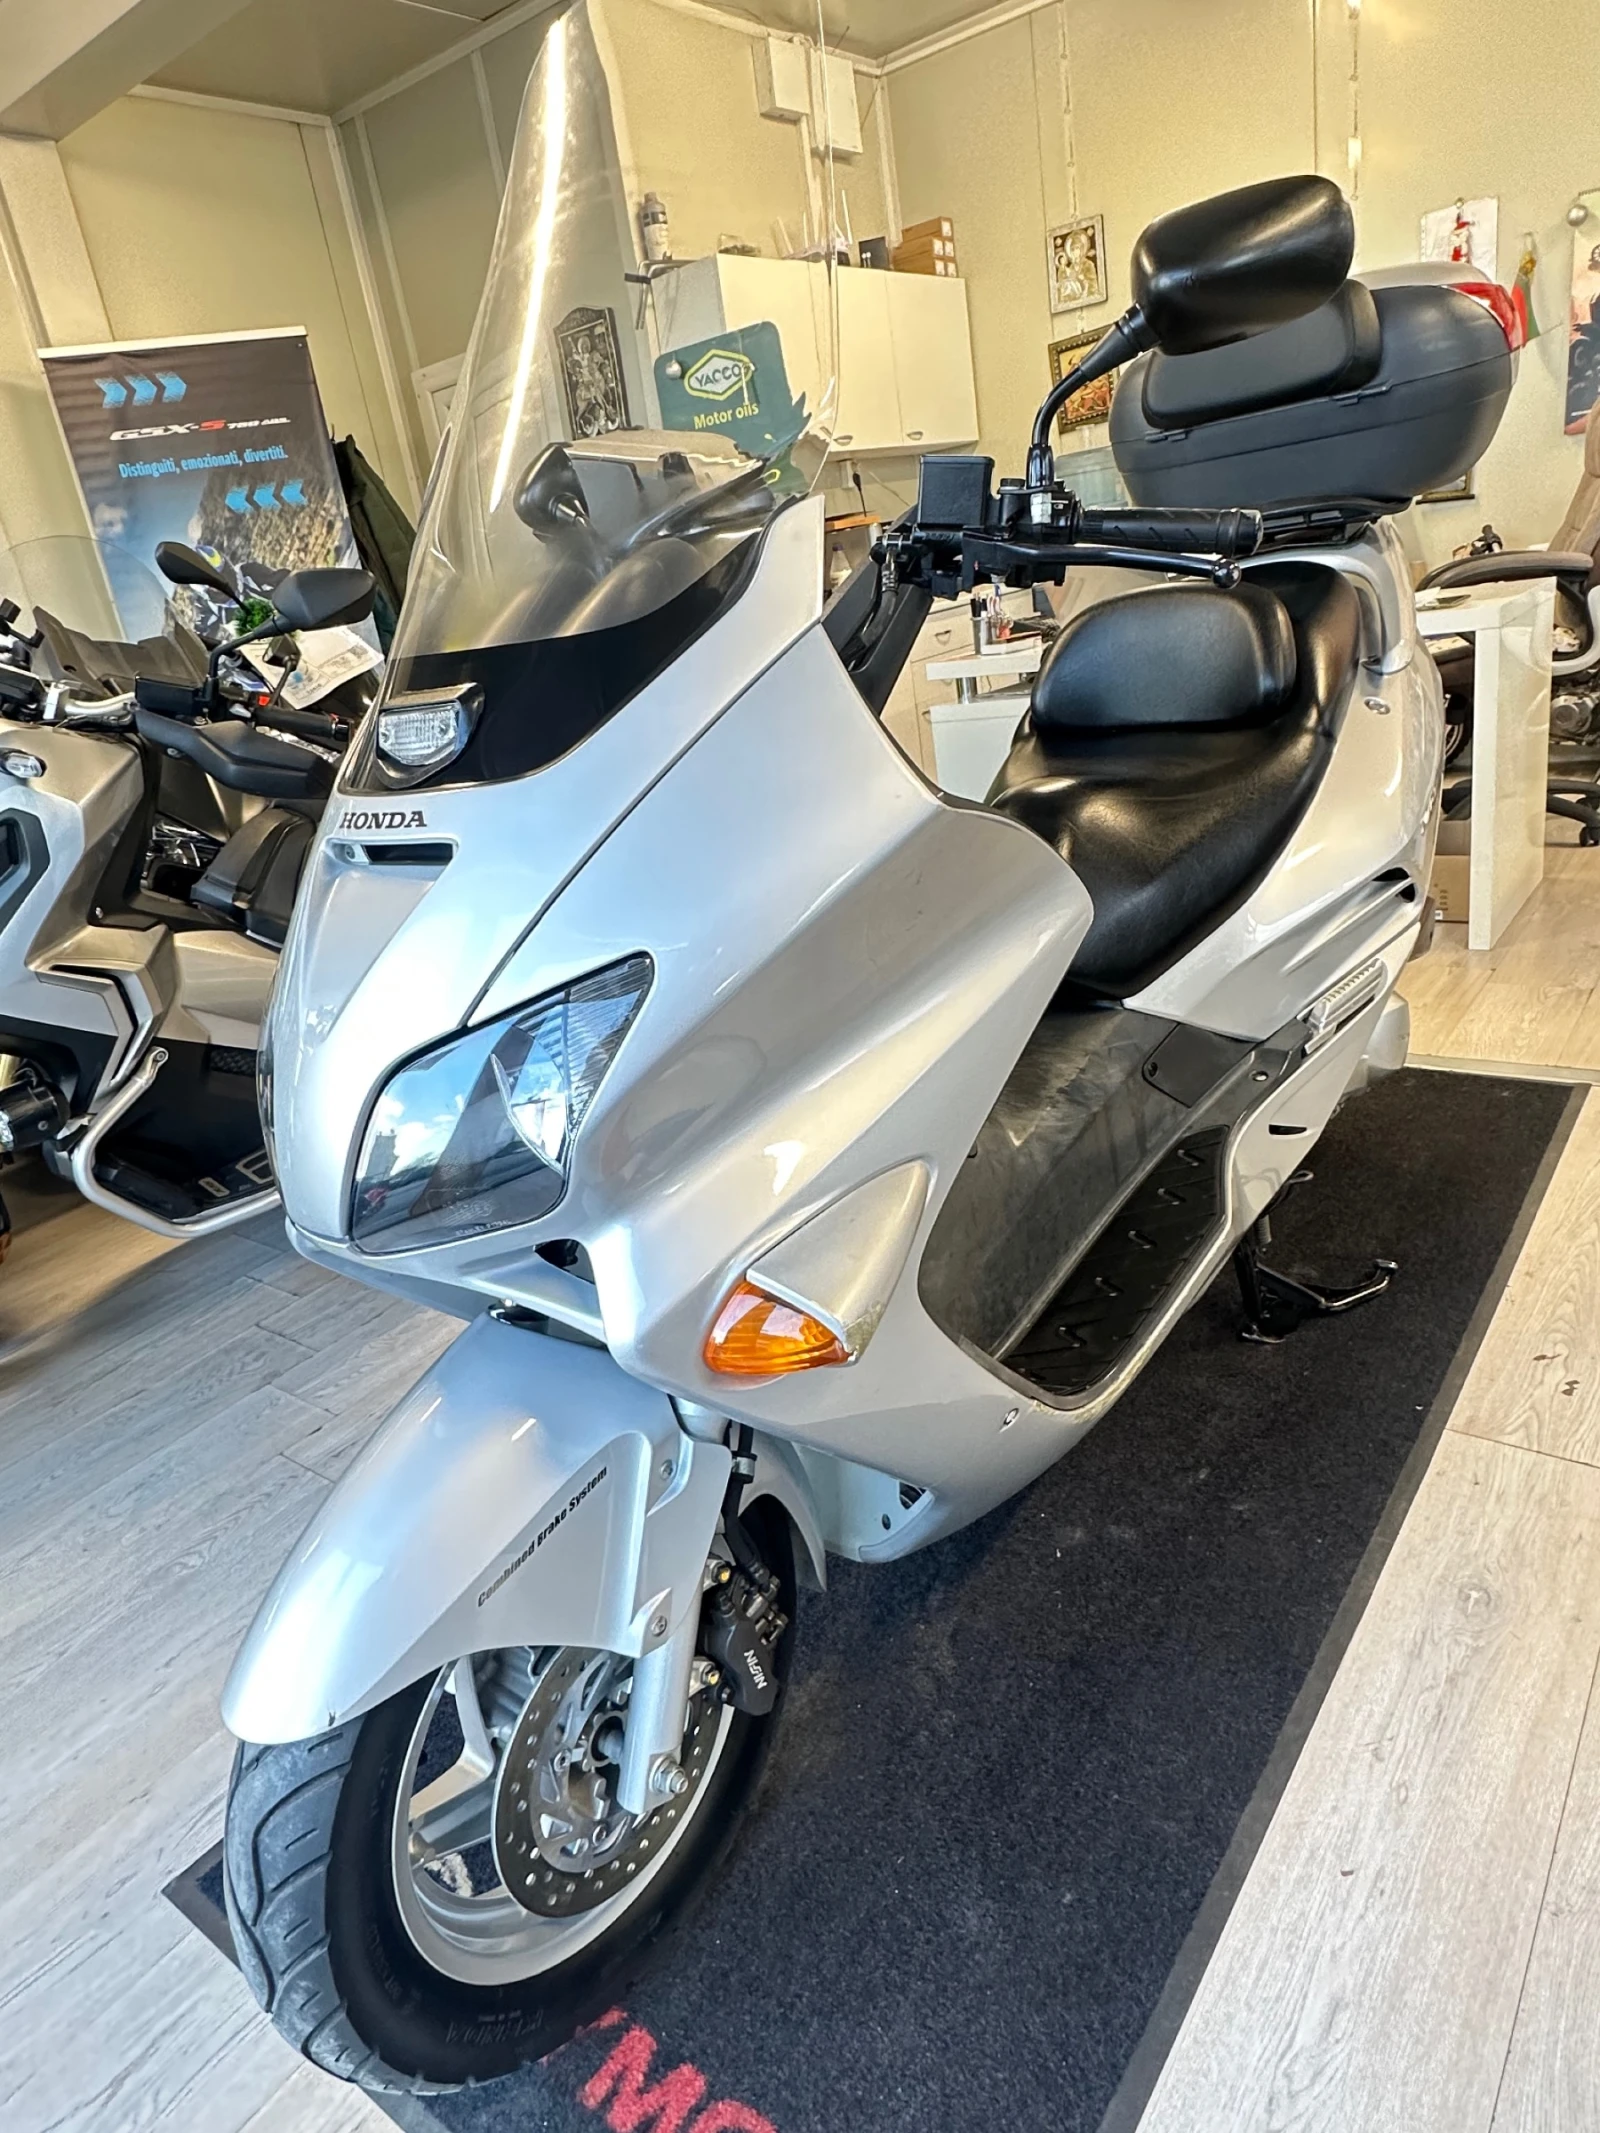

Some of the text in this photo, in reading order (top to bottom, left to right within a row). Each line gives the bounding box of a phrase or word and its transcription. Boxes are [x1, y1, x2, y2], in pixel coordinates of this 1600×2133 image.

[694, 363, 742, 388] YACCO
[109, 419, 227, 441] GSX-S
[693, 402, 760, 430] Motor oils
[118, 444, 289, 479] Distinguiti, emozionati, divertiti.
[339, 810, 427, 830] HONDA
[477, 1466, 608, 1608] Combined Brake System
[743, 1649, 768, 1690] NISSIN
